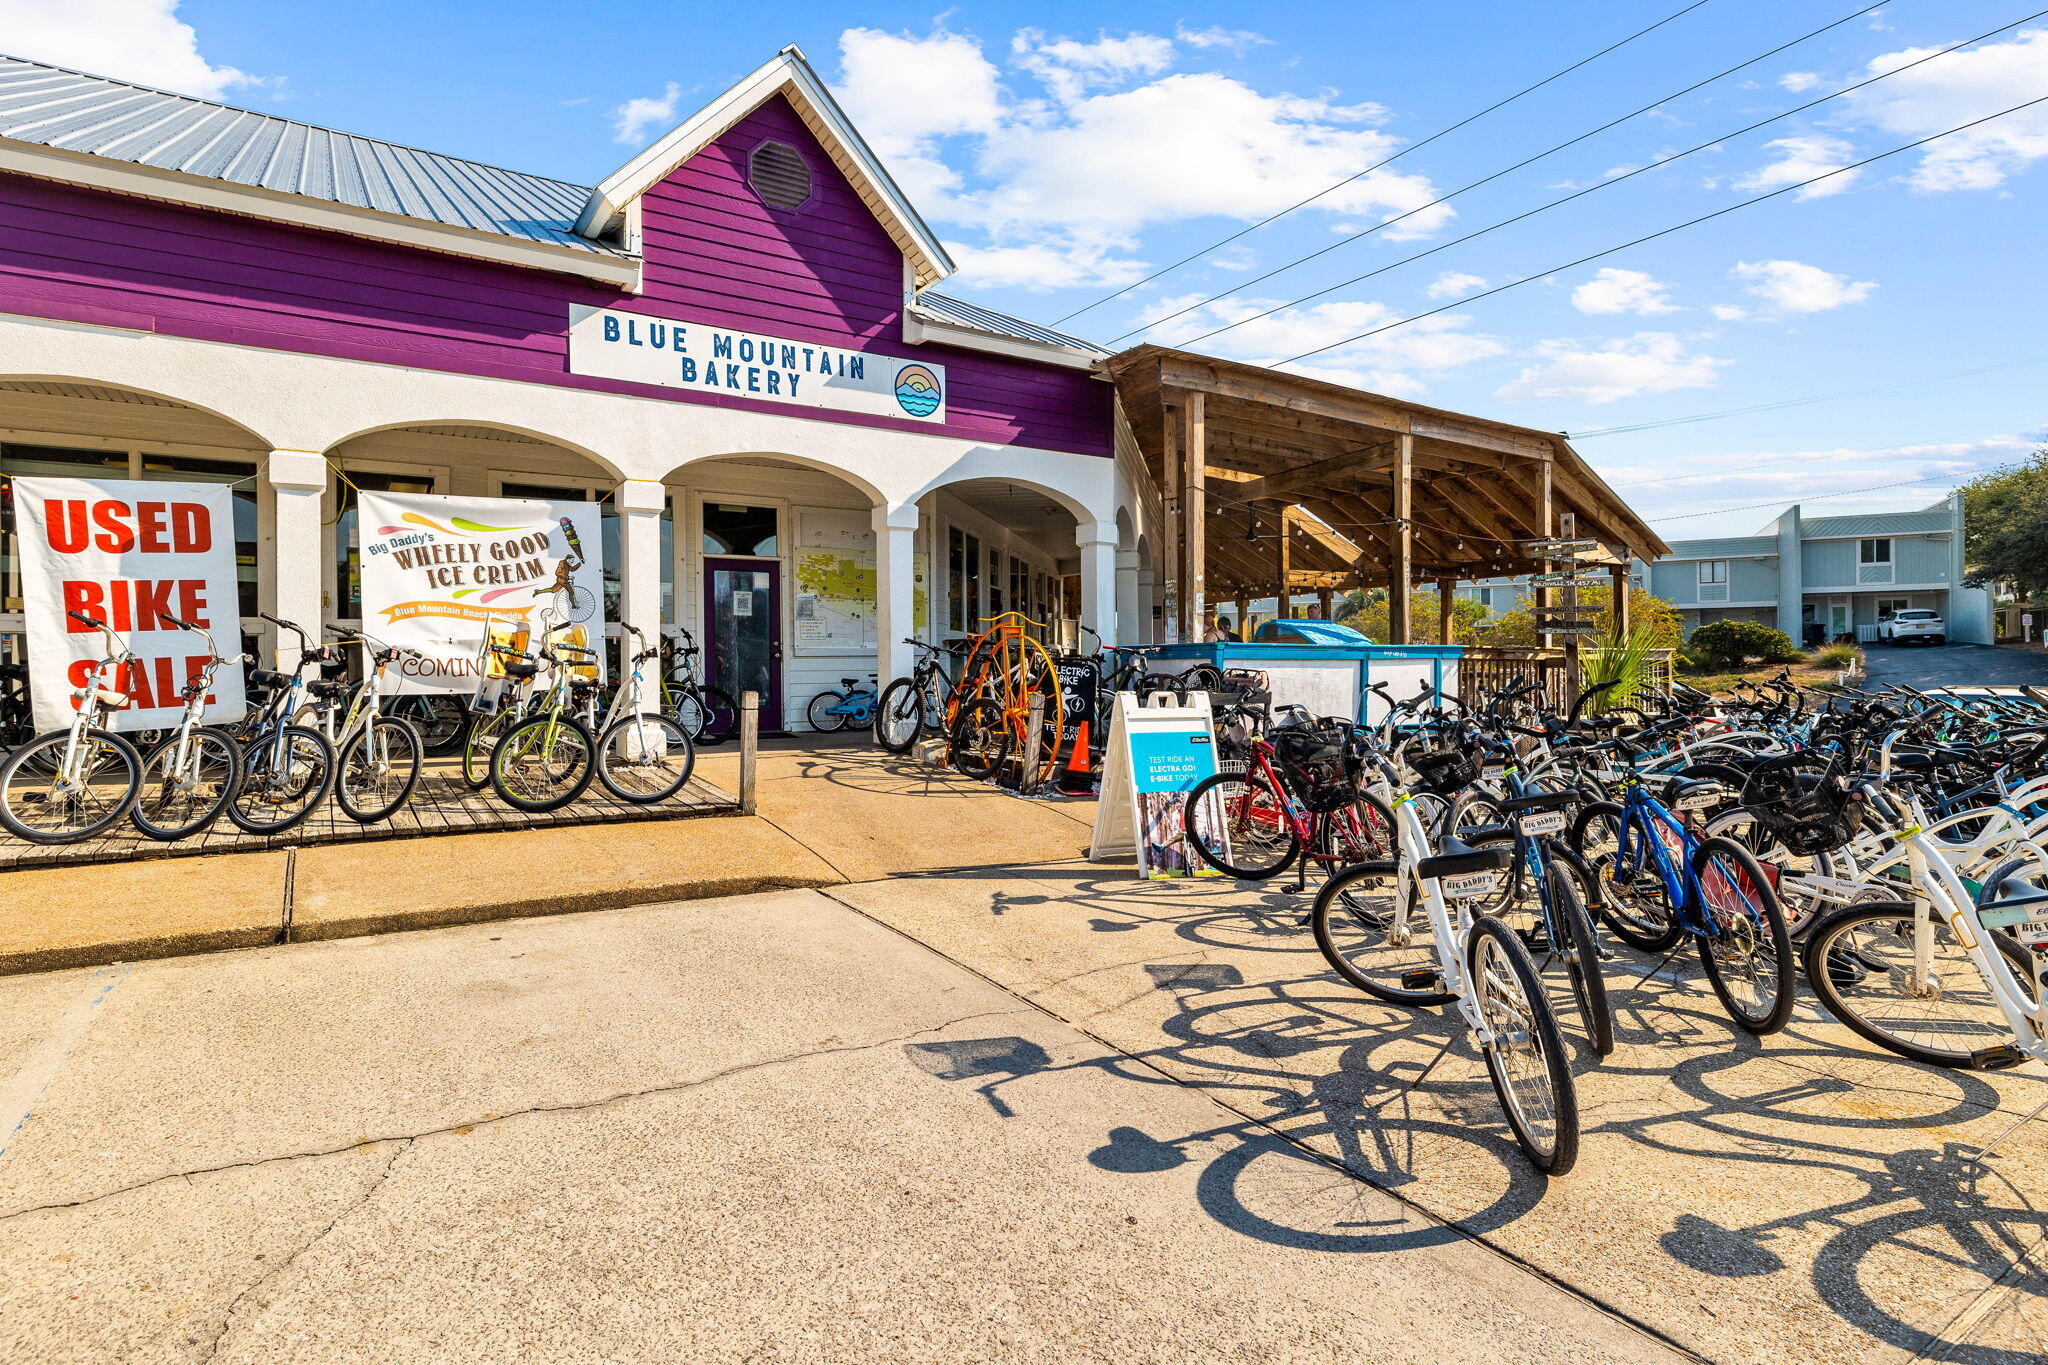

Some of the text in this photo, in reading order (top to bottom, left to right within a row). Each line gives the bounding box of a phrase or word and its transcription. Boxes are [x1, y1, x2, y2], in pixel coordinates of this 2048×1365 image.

[604, 315, 865, 380] BLUE MOUNTAIN
[682, 357, 801, 398] BAKERY
[44, 499, 212, 553] USED
[368, 532, 435, 556] Big Daddy's
[391, 531, 551, 571] WHEELY GOOD
[426, 557, 547, 589] ICE CREAM
[62, 579, 211, 634] BIKE
[394, 606, 415, 617] Blue
[417, 604, 460, 616] Mountain
[402, 656, 484, 678] COMIN
[1054, 664, 1090, 679] LECTRIC
[67, 655, 217, 711] SALE
[1058, 674, 1079, 686] BIKE
[1044, 723, 1068, 733] TET
[1167, 755, 1183, 763] RIDE
[1149, 765, 1181, 773] ELECTRA
[1150, 774, 1198, 783] E-BIKE TODAY
[1536, 816, 1562, 827] DADDY'S
[1446, 875, 1493, 889] BIG DADDY'S
[2021, 923, 2042, 932] BIG
